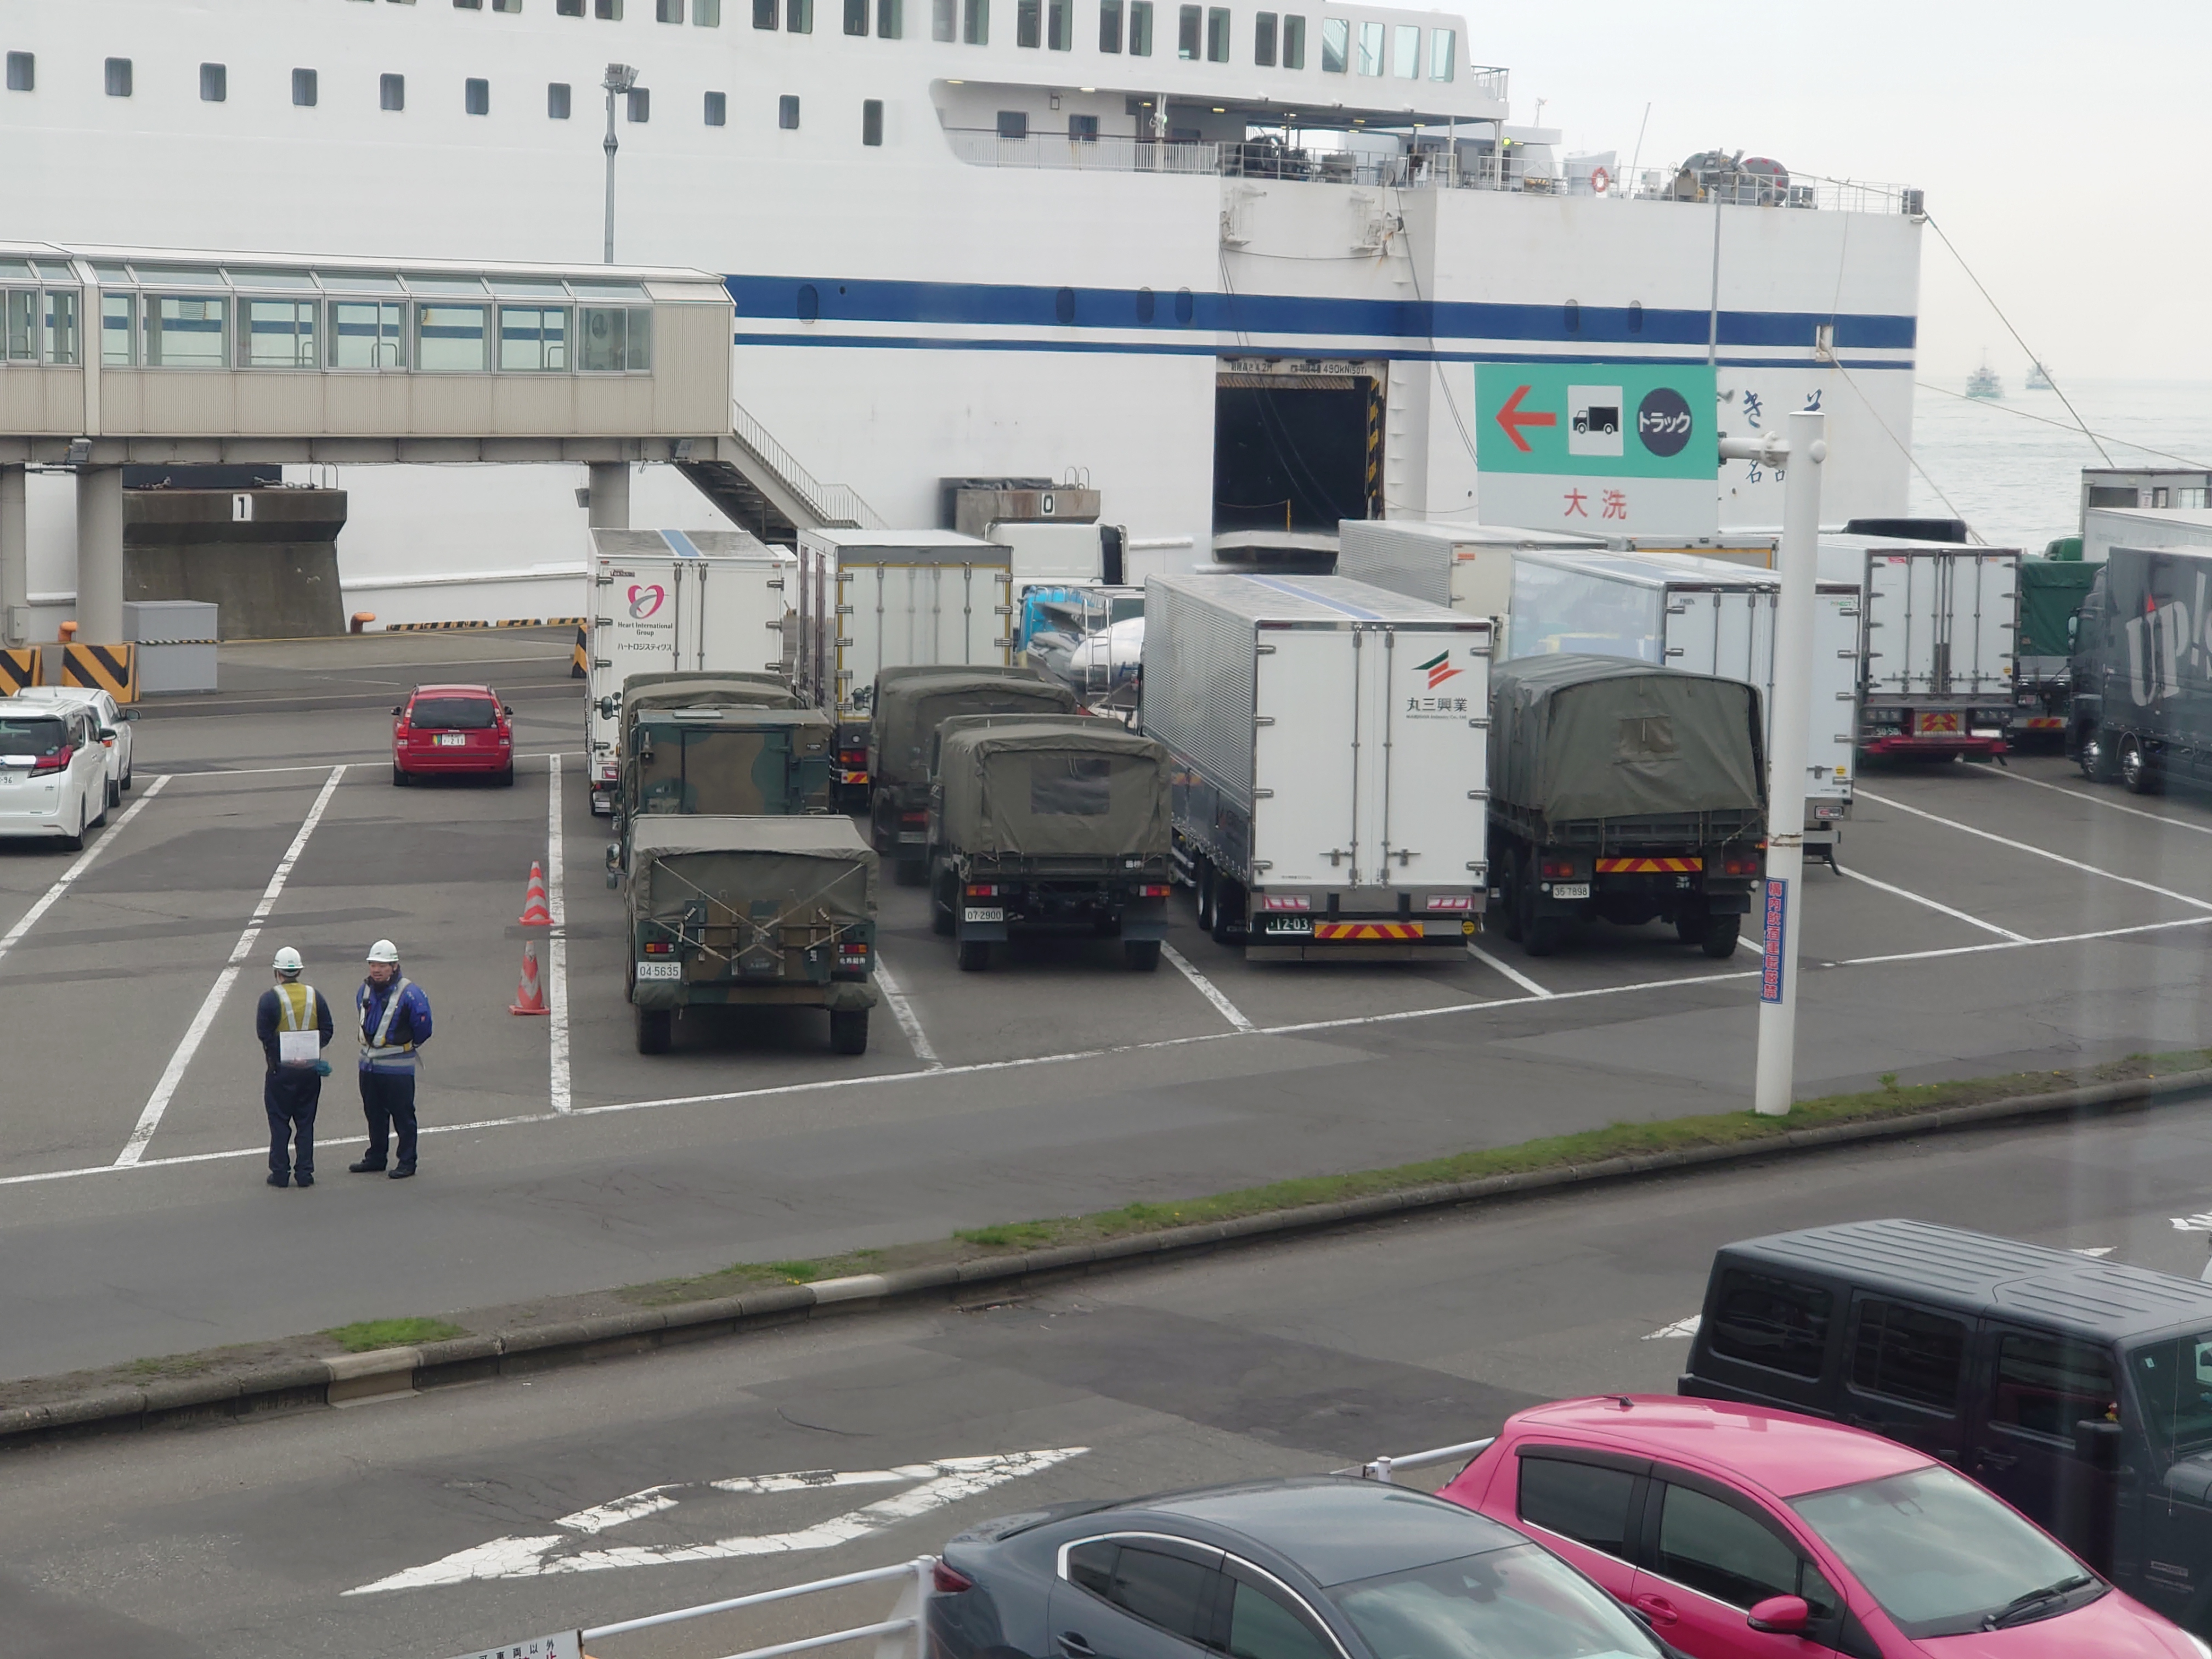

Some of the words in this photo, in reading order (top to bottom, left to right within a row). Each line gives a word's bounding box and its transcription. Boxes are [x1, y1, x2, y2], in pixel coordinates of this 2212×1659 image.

[1639, 411, 1690, 433] トラック
[238, 496, 245, 518] 1
[1043, 495, 1053, 514] 0
[1564, 488, 1627, 520] 大洗
[618, 643, 672, 651] ハートロジスティクス
[1407, 697, 1468, 712] 丸三興業
[1277, 918, 1308, 930] 12-03
